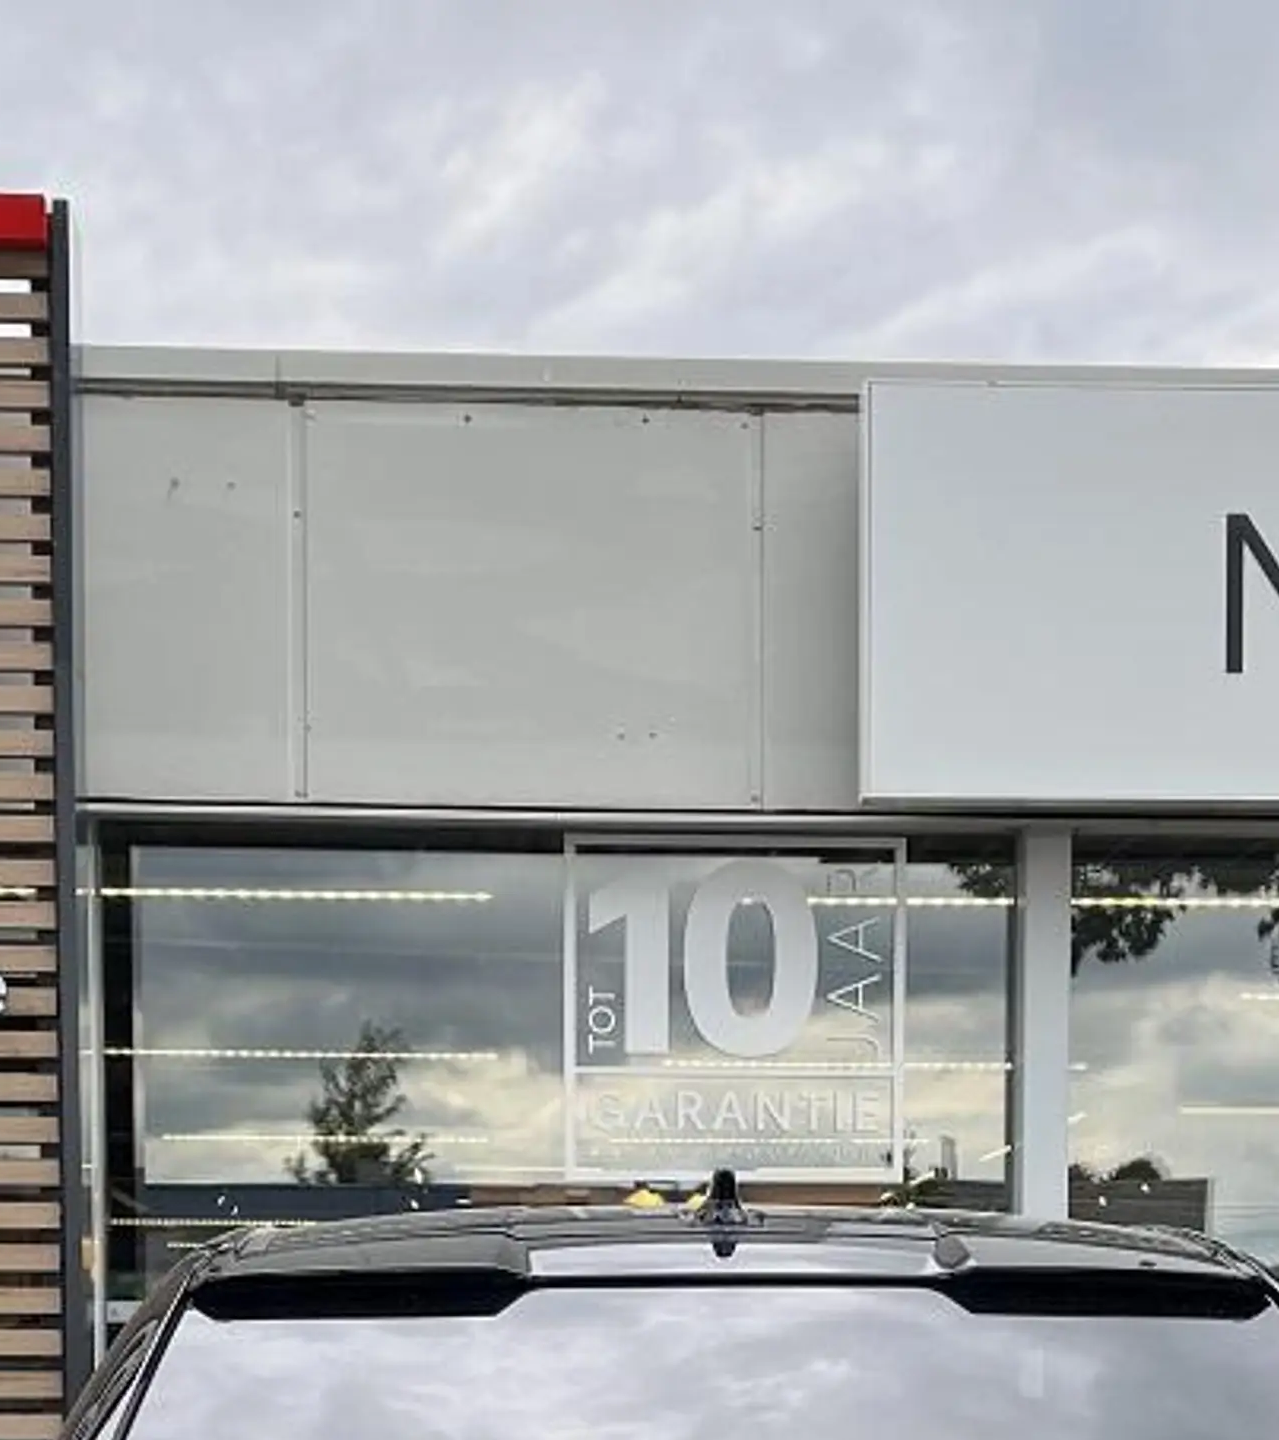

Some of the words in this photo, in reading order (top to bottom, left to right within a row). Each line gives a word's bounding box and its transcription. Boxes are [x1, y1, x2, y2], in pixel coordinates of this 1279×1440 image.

[587, 985, 616, 1055] TOT
[588, 860, 819, 1058] 10
[825, 858, 884, 1068] JAAR
[591, 1088, 883, 1134] GARANTIE
